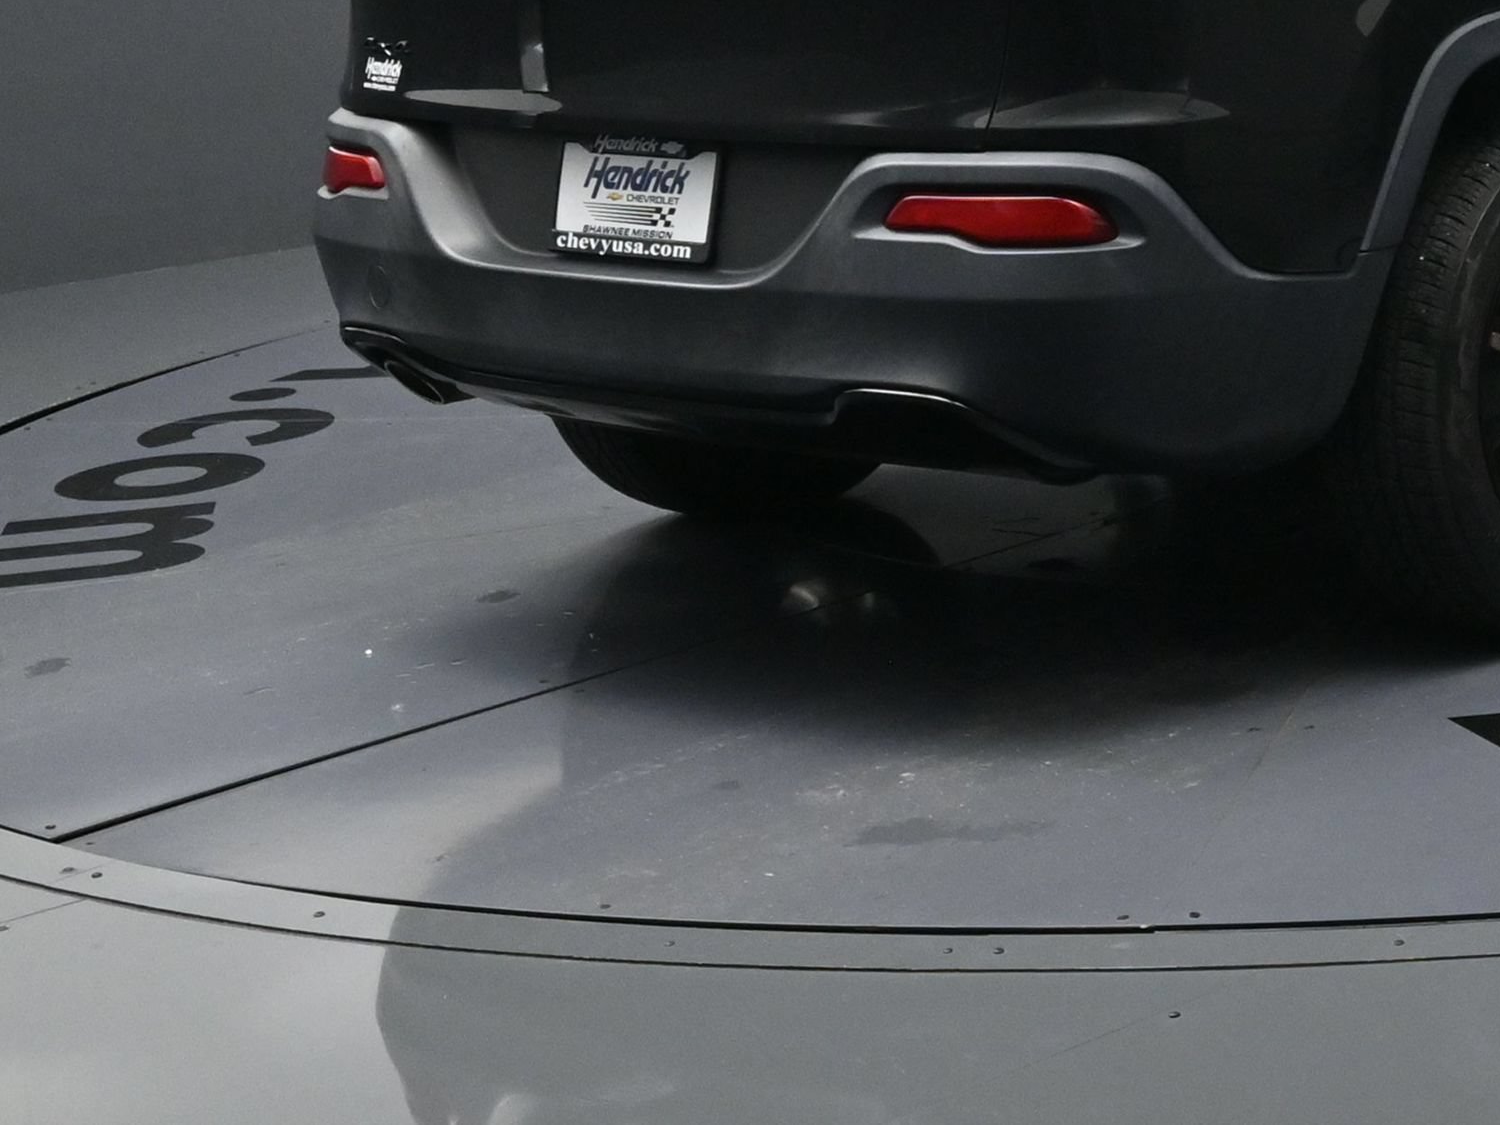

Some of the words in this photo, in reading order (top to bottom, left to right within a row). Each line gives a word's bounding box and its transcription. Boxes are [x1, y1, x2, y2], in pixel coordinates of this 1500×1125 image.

[594, 135, 658, 154] Hendrick
[584, 156, 690, 199] Hendrick
[626, 193, 679, 205] CHEVROLET
[582, 224, 630, 236] SHAWNEE
[631, 228, 673, 239] MISSION
[556, 232, 692, 259] chevyusa.com
